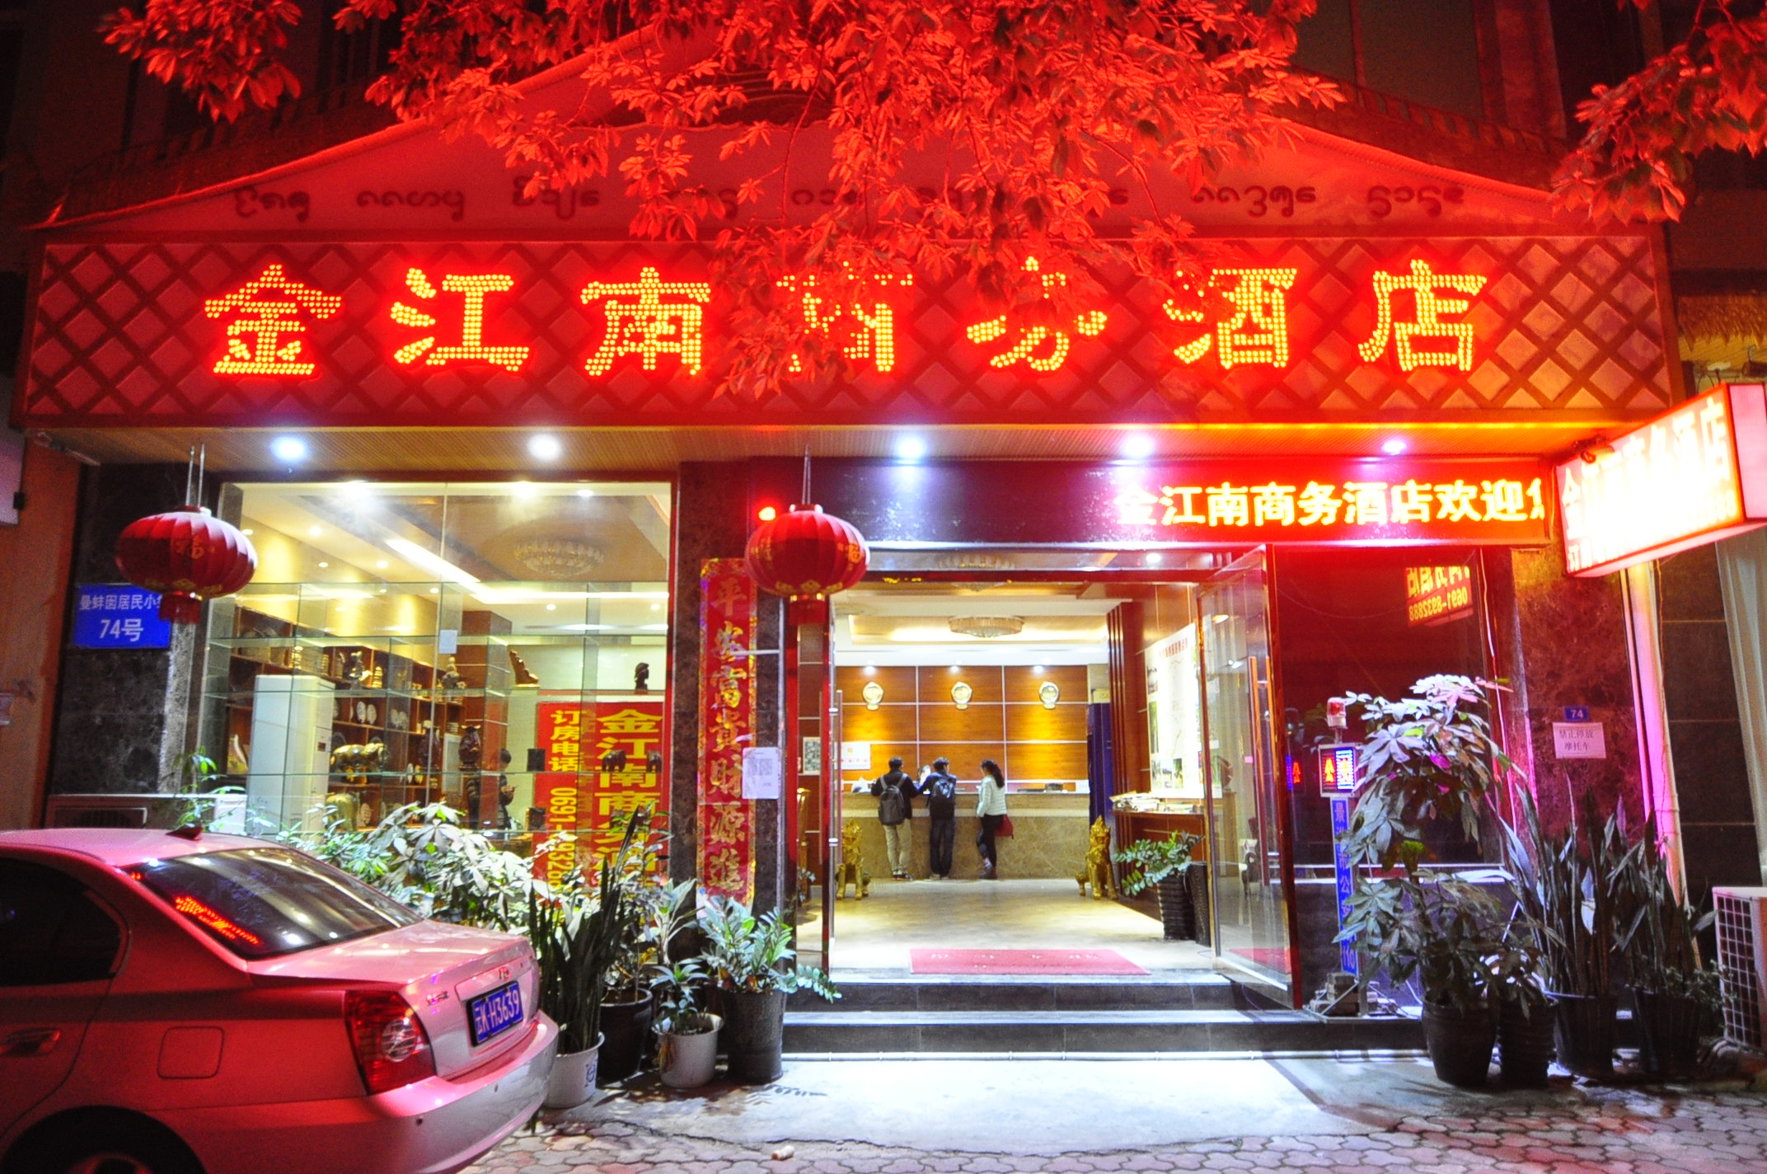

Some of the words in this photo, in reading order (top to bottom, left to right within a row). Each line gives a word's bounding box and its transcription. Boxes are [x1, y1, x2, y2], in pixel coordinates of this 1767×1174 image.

[99, 618, 144, 642] 74号
[1570, 709, 1584, 719] 74
[549, 710, 581, 772] 订房电话
